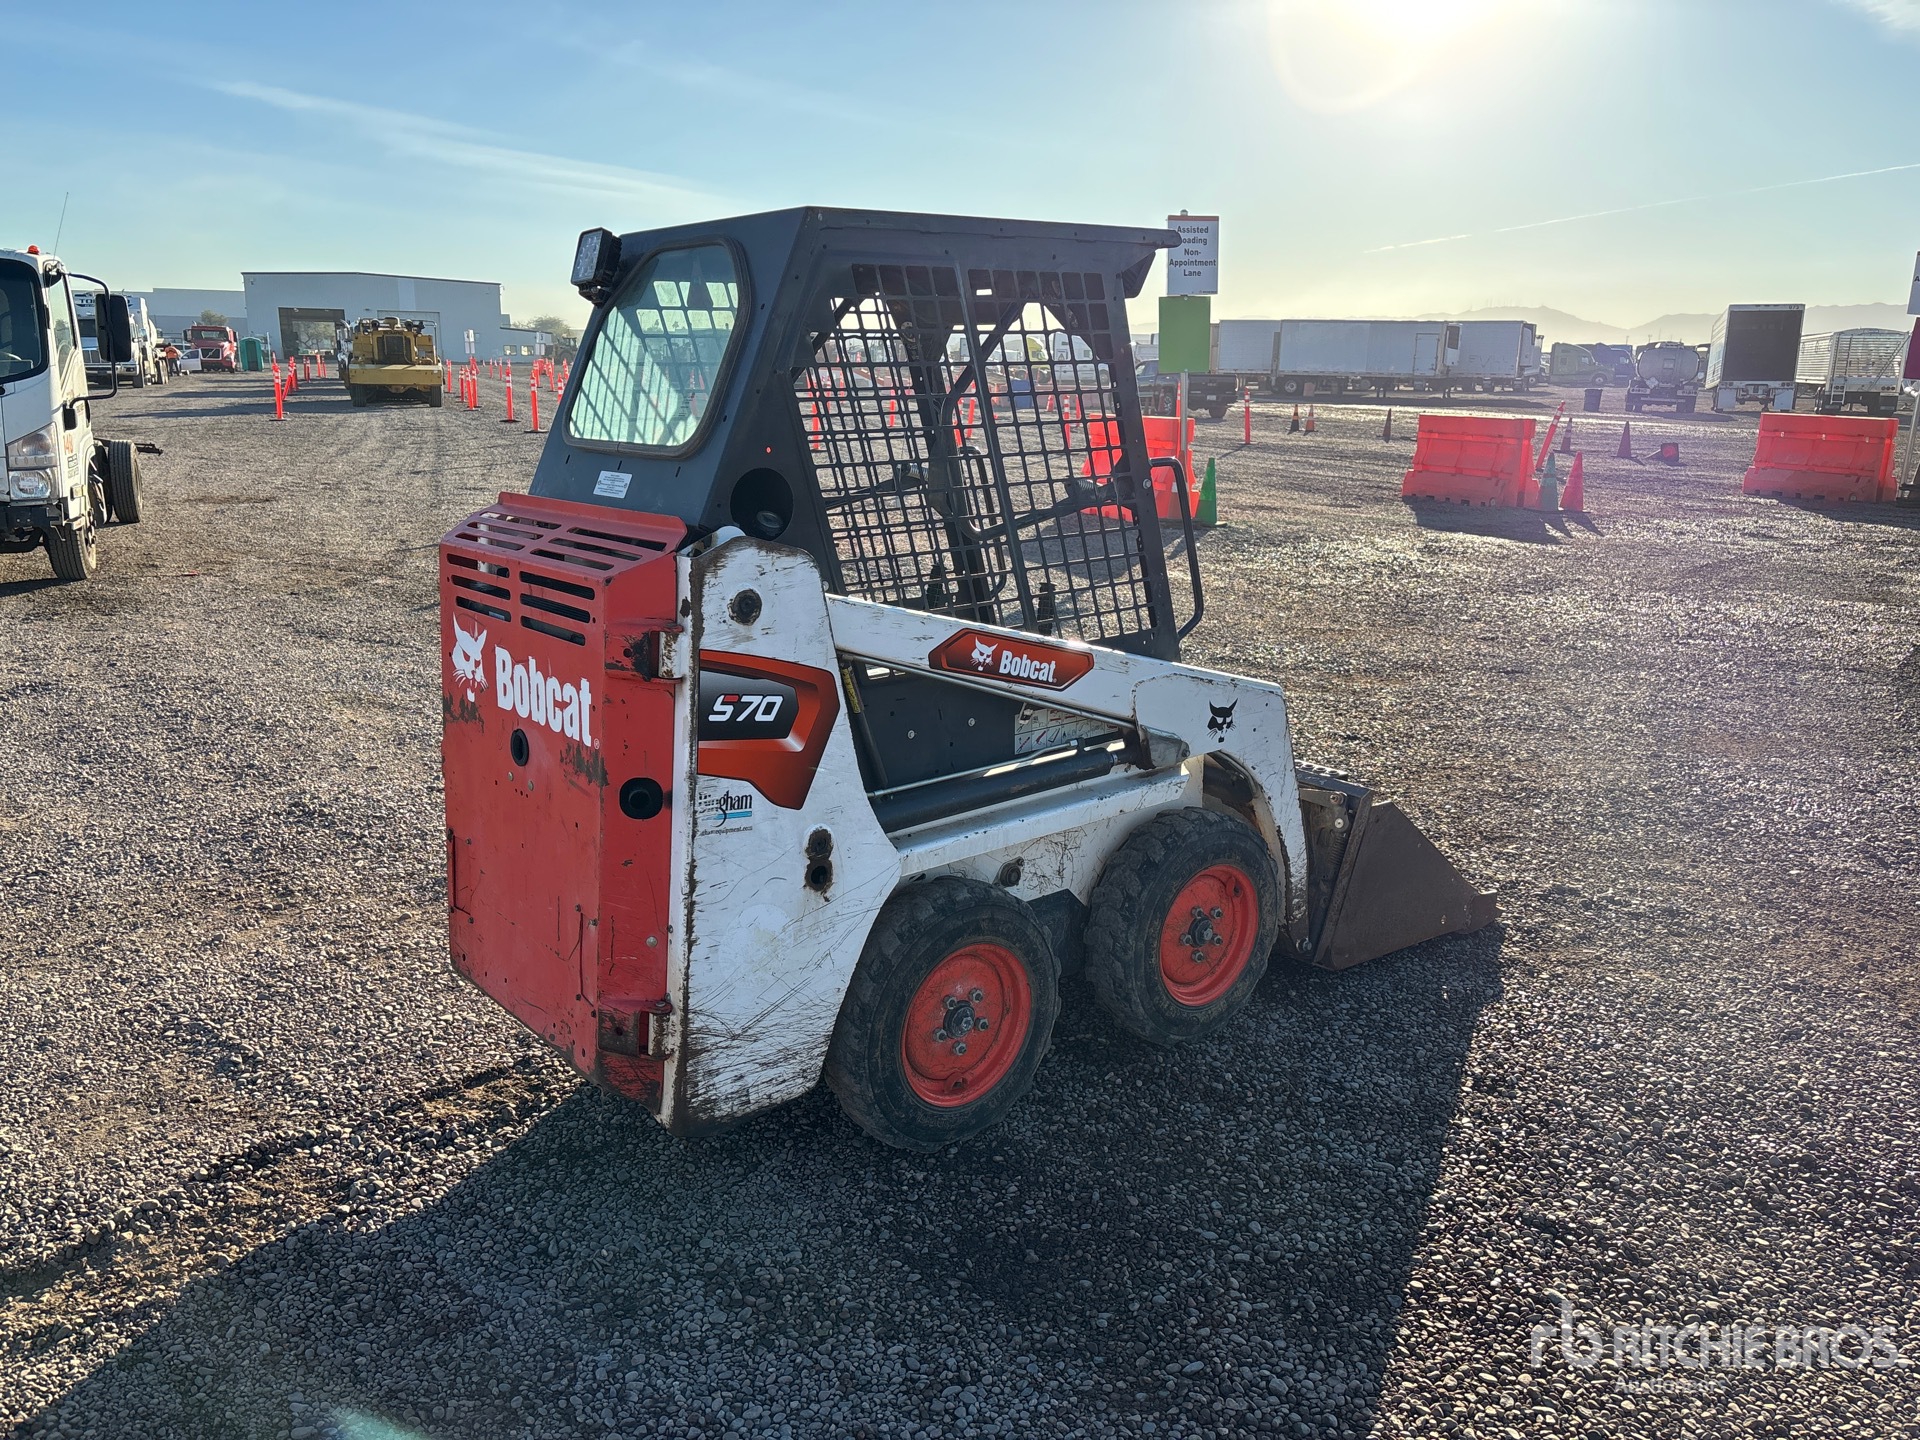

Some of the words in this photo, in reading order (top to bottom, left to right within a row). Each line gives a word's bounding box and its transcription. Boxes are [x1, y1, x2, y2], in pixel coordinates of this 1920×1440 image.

[1177, 225, 1209, 234] Assisted
[1181, 236, 1208, 246] oading
[1184, 248, 1202, 256] Non-
[1169, 258, 1217, 268] Appointment
[1183, 269, 1202, 277] Lane
[999, 650, 1056, 683] Bobcat
[494, 644, 592, 747] Bobcat
[708, 694, 784, 722] S70
